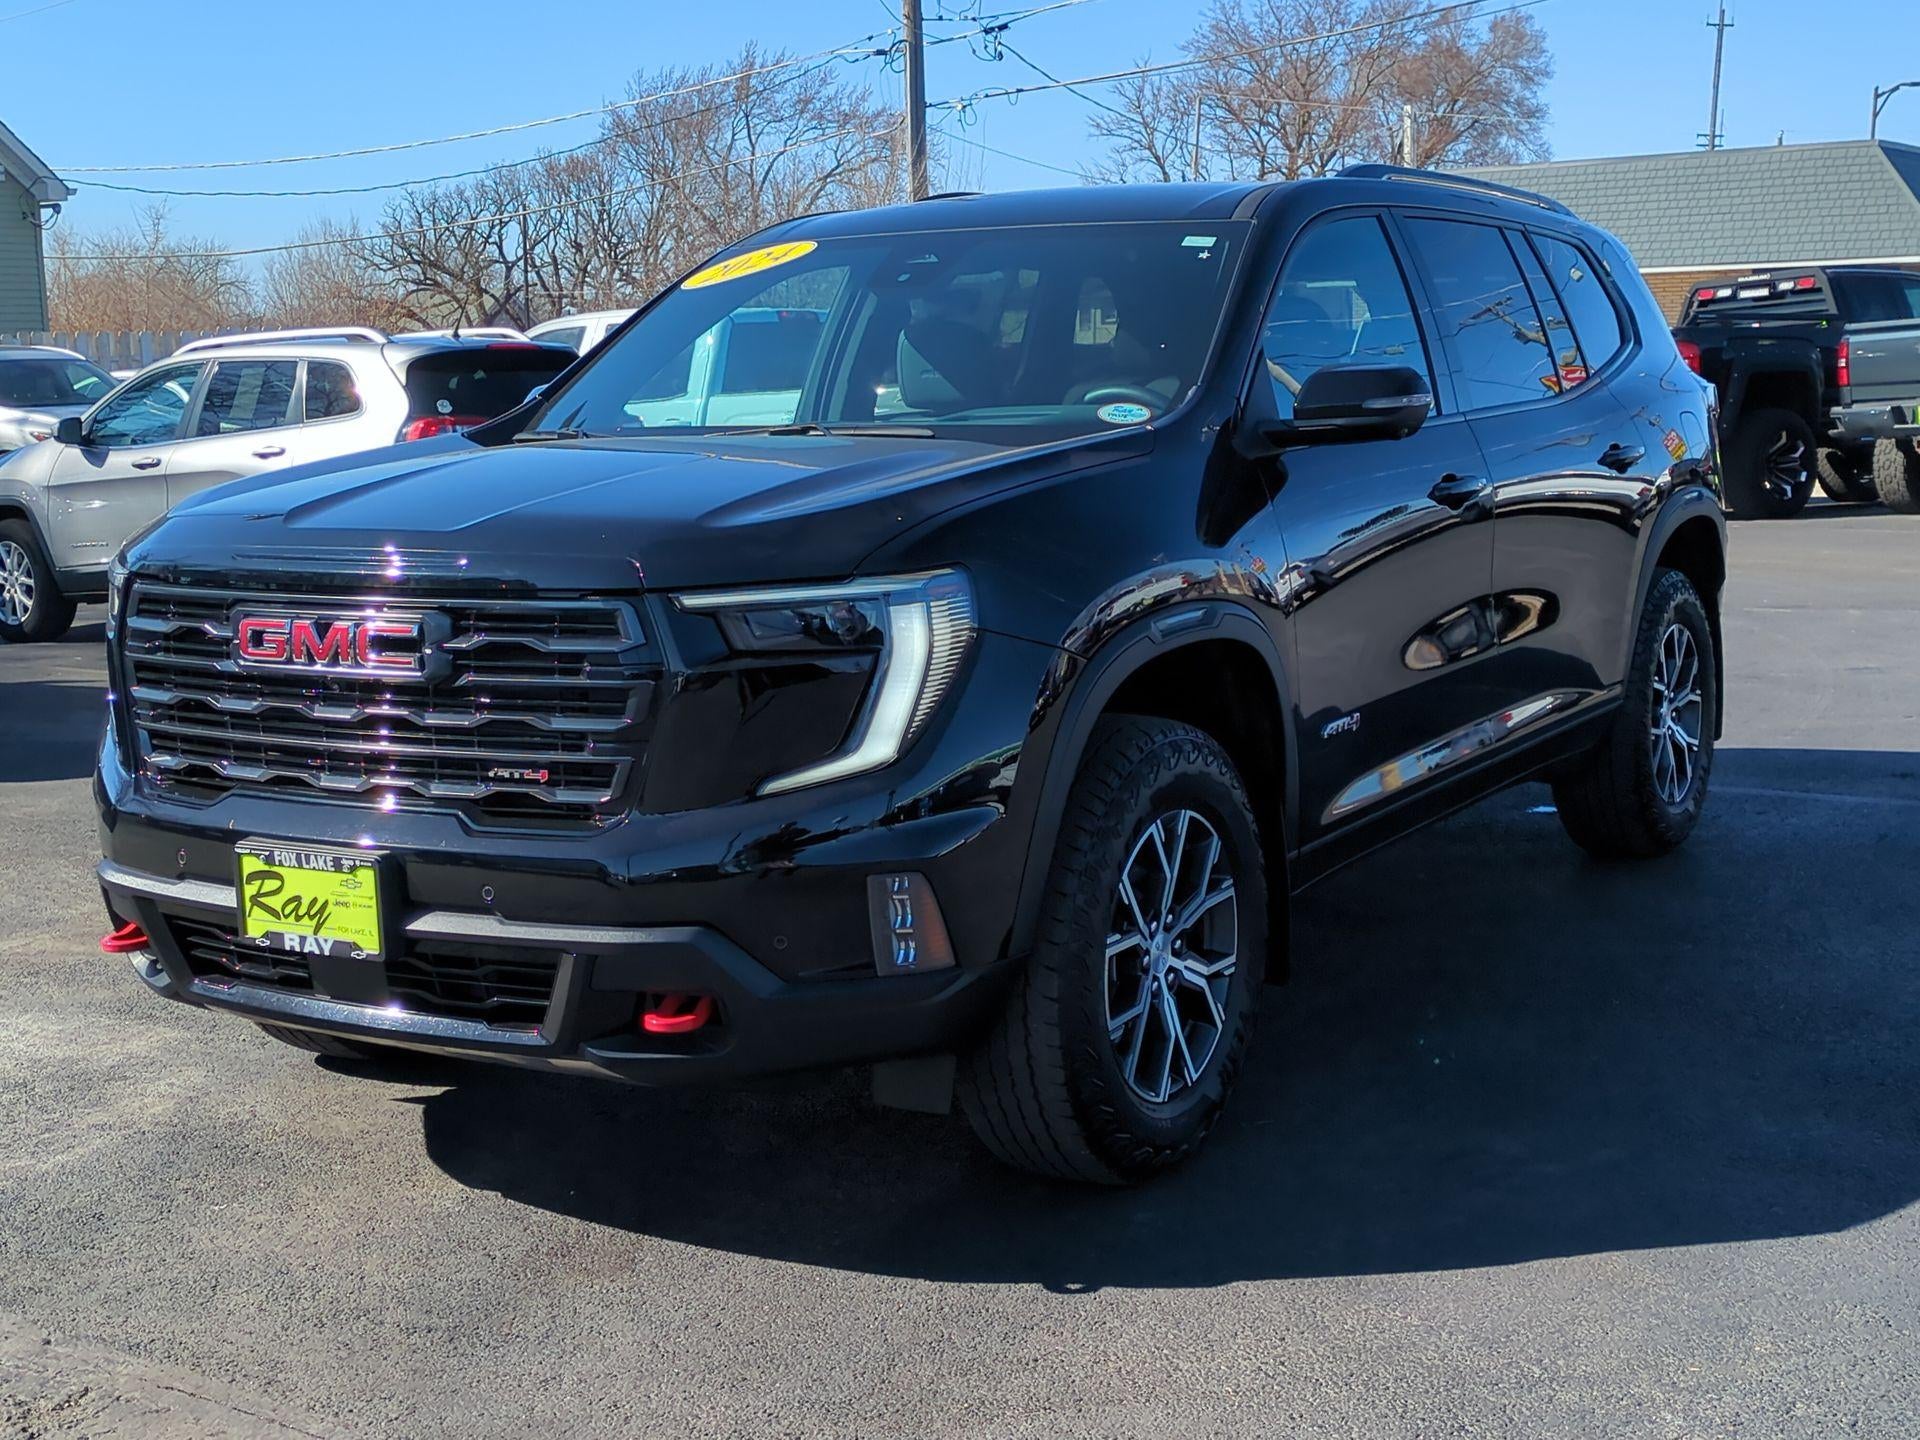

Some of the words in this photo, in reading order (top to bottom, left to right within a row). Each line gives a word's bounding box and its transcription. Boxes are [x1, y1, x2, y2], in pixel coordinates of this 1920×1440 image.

[237, 617, 424, 669] GMC
[1323, 711, 1361, 740] AT4
[487, 767, 549, 783] AT4
[273, 850, 298, 868] FOX
[301, 853, 335, 872] LAKE
[244, 870, 332, 936] Ray
[332, 899, 351, 909] Jeep
[283, 933, 335, 956] RAY
